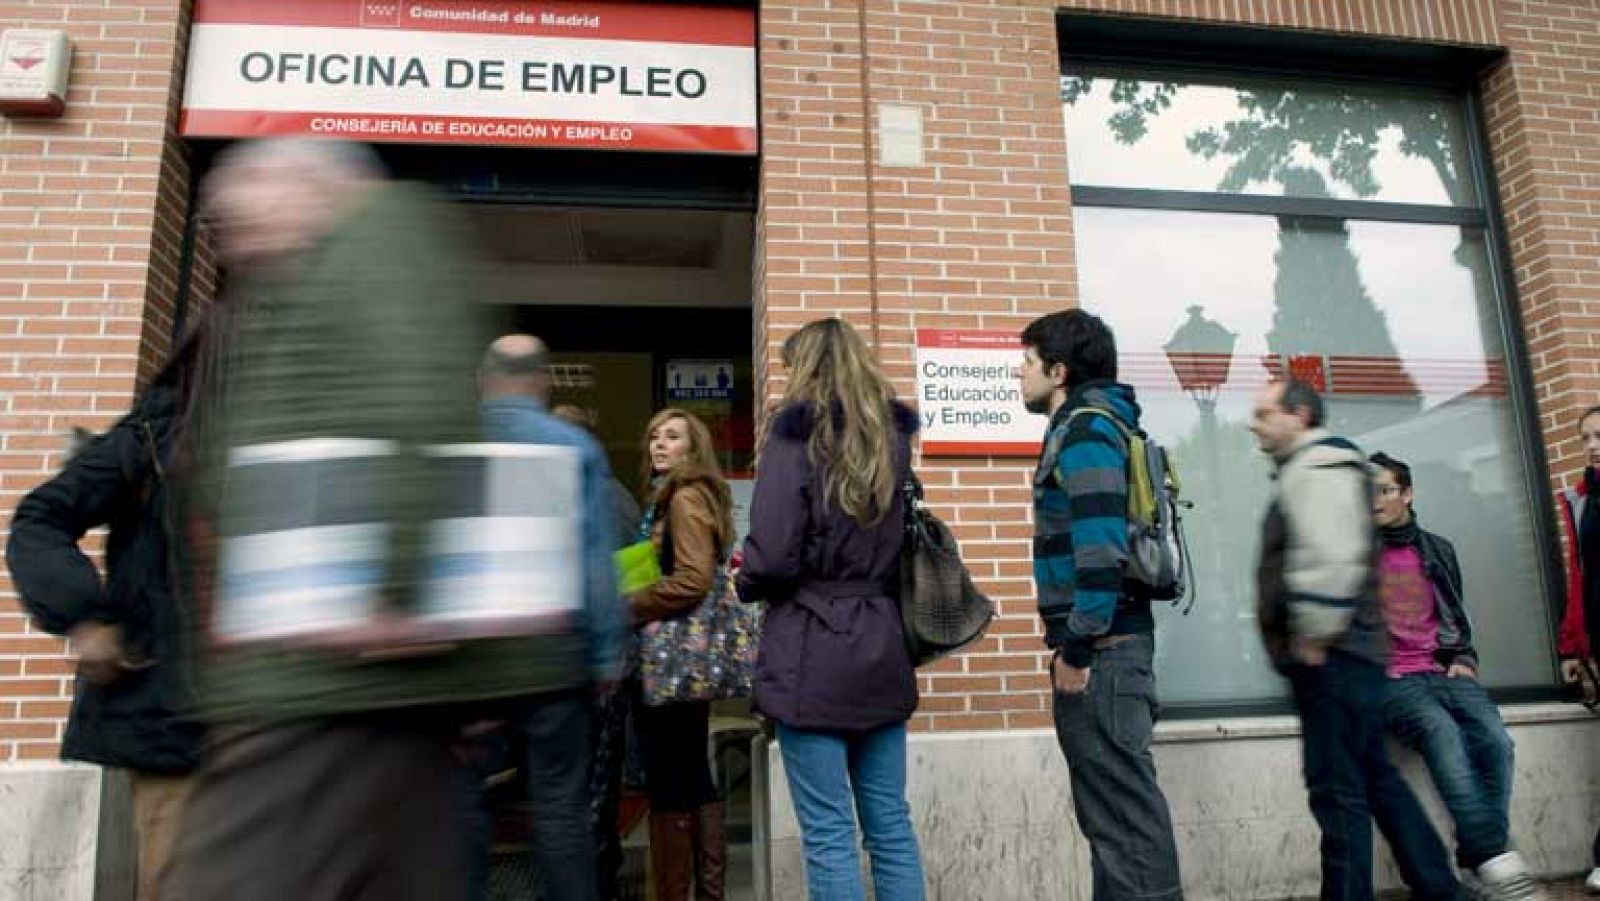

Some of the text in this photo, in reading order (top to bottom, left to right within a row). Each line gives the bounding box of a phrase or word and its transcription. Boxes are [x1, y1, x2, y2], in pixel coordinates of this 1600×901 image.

[410, 6, 600, 28] Comunidad de Madrid
[240, 51, 707, 99] OFICINA DE EMPLEO
[310, 117, 633, 141] CONSEJERÍA DE EDUCACIÓN Y EMPLEO
[924, 383, 1019, 401] Educación
[924, 407, 1010, 428] y Empleo
